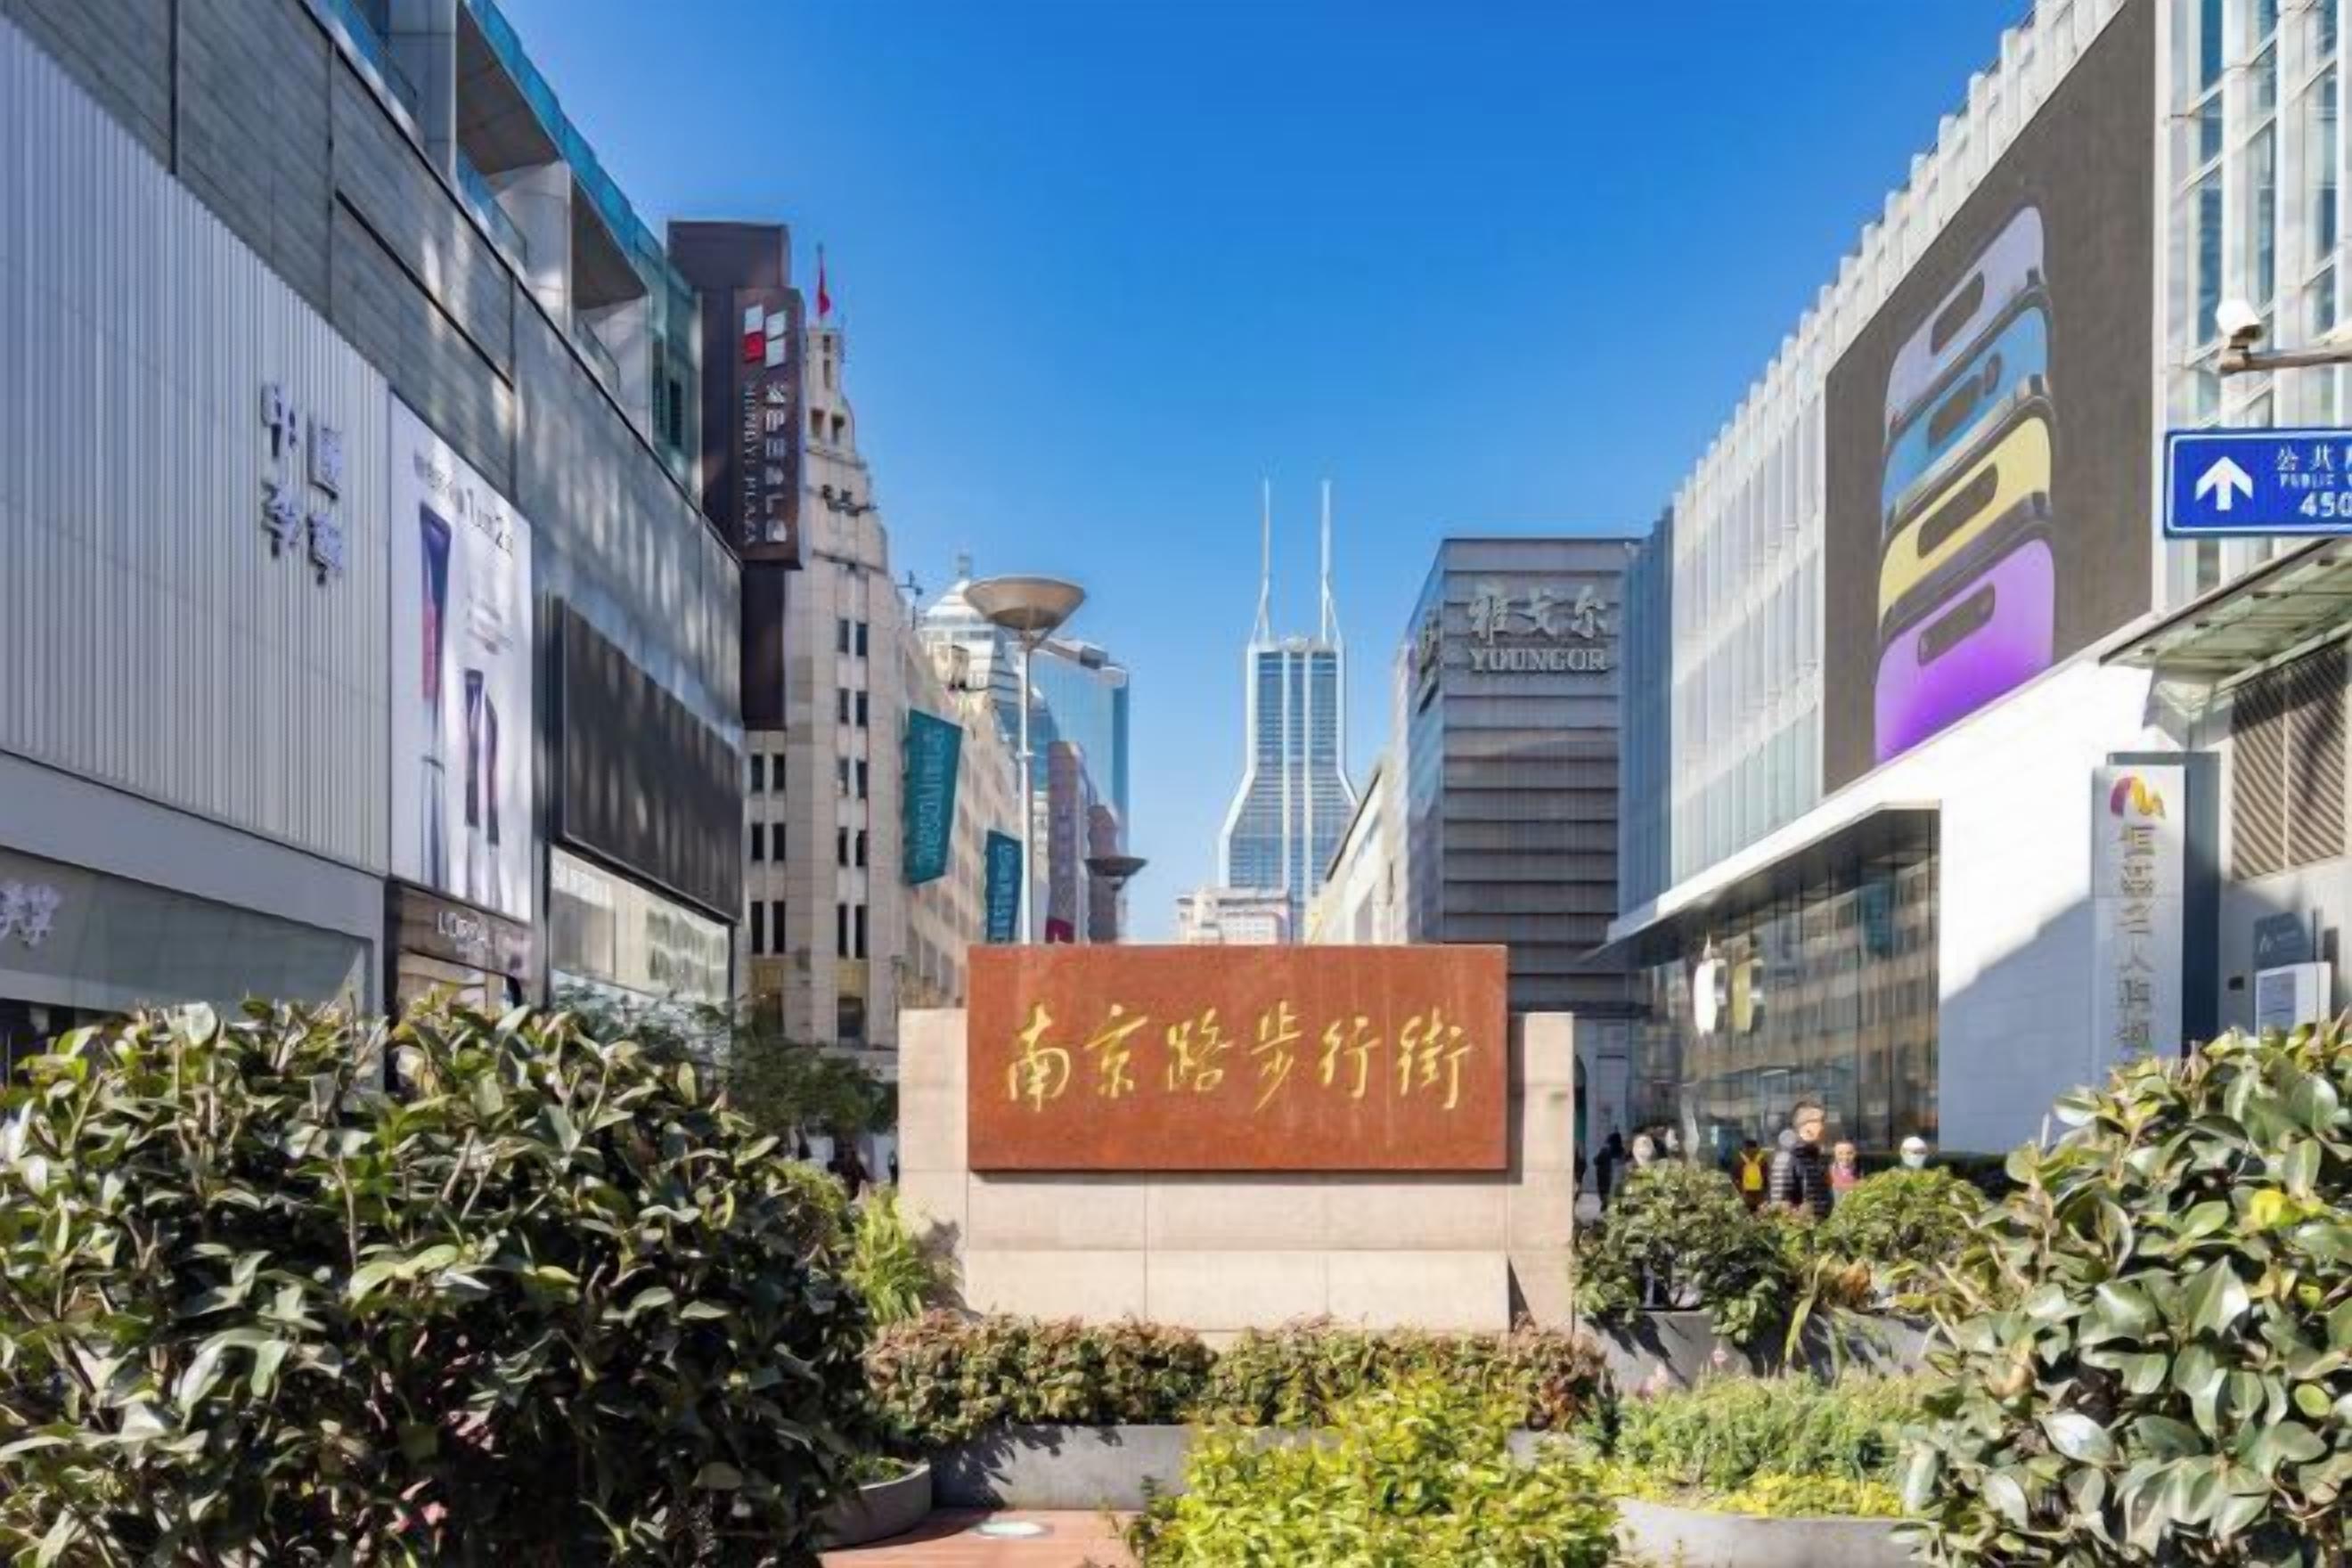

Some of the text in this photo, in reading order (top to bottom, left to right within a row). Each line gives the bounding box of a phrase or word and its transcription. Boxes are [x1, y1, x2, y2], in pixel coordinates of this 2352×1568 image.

[2275, 444, 2352, 473] 公共
[2280, 472, 2335, 489] PUBLIC
[1470, 648, 1607, 673] YOUNGOR
[1008, 1000, 1474, 1114] 南京路步行街
